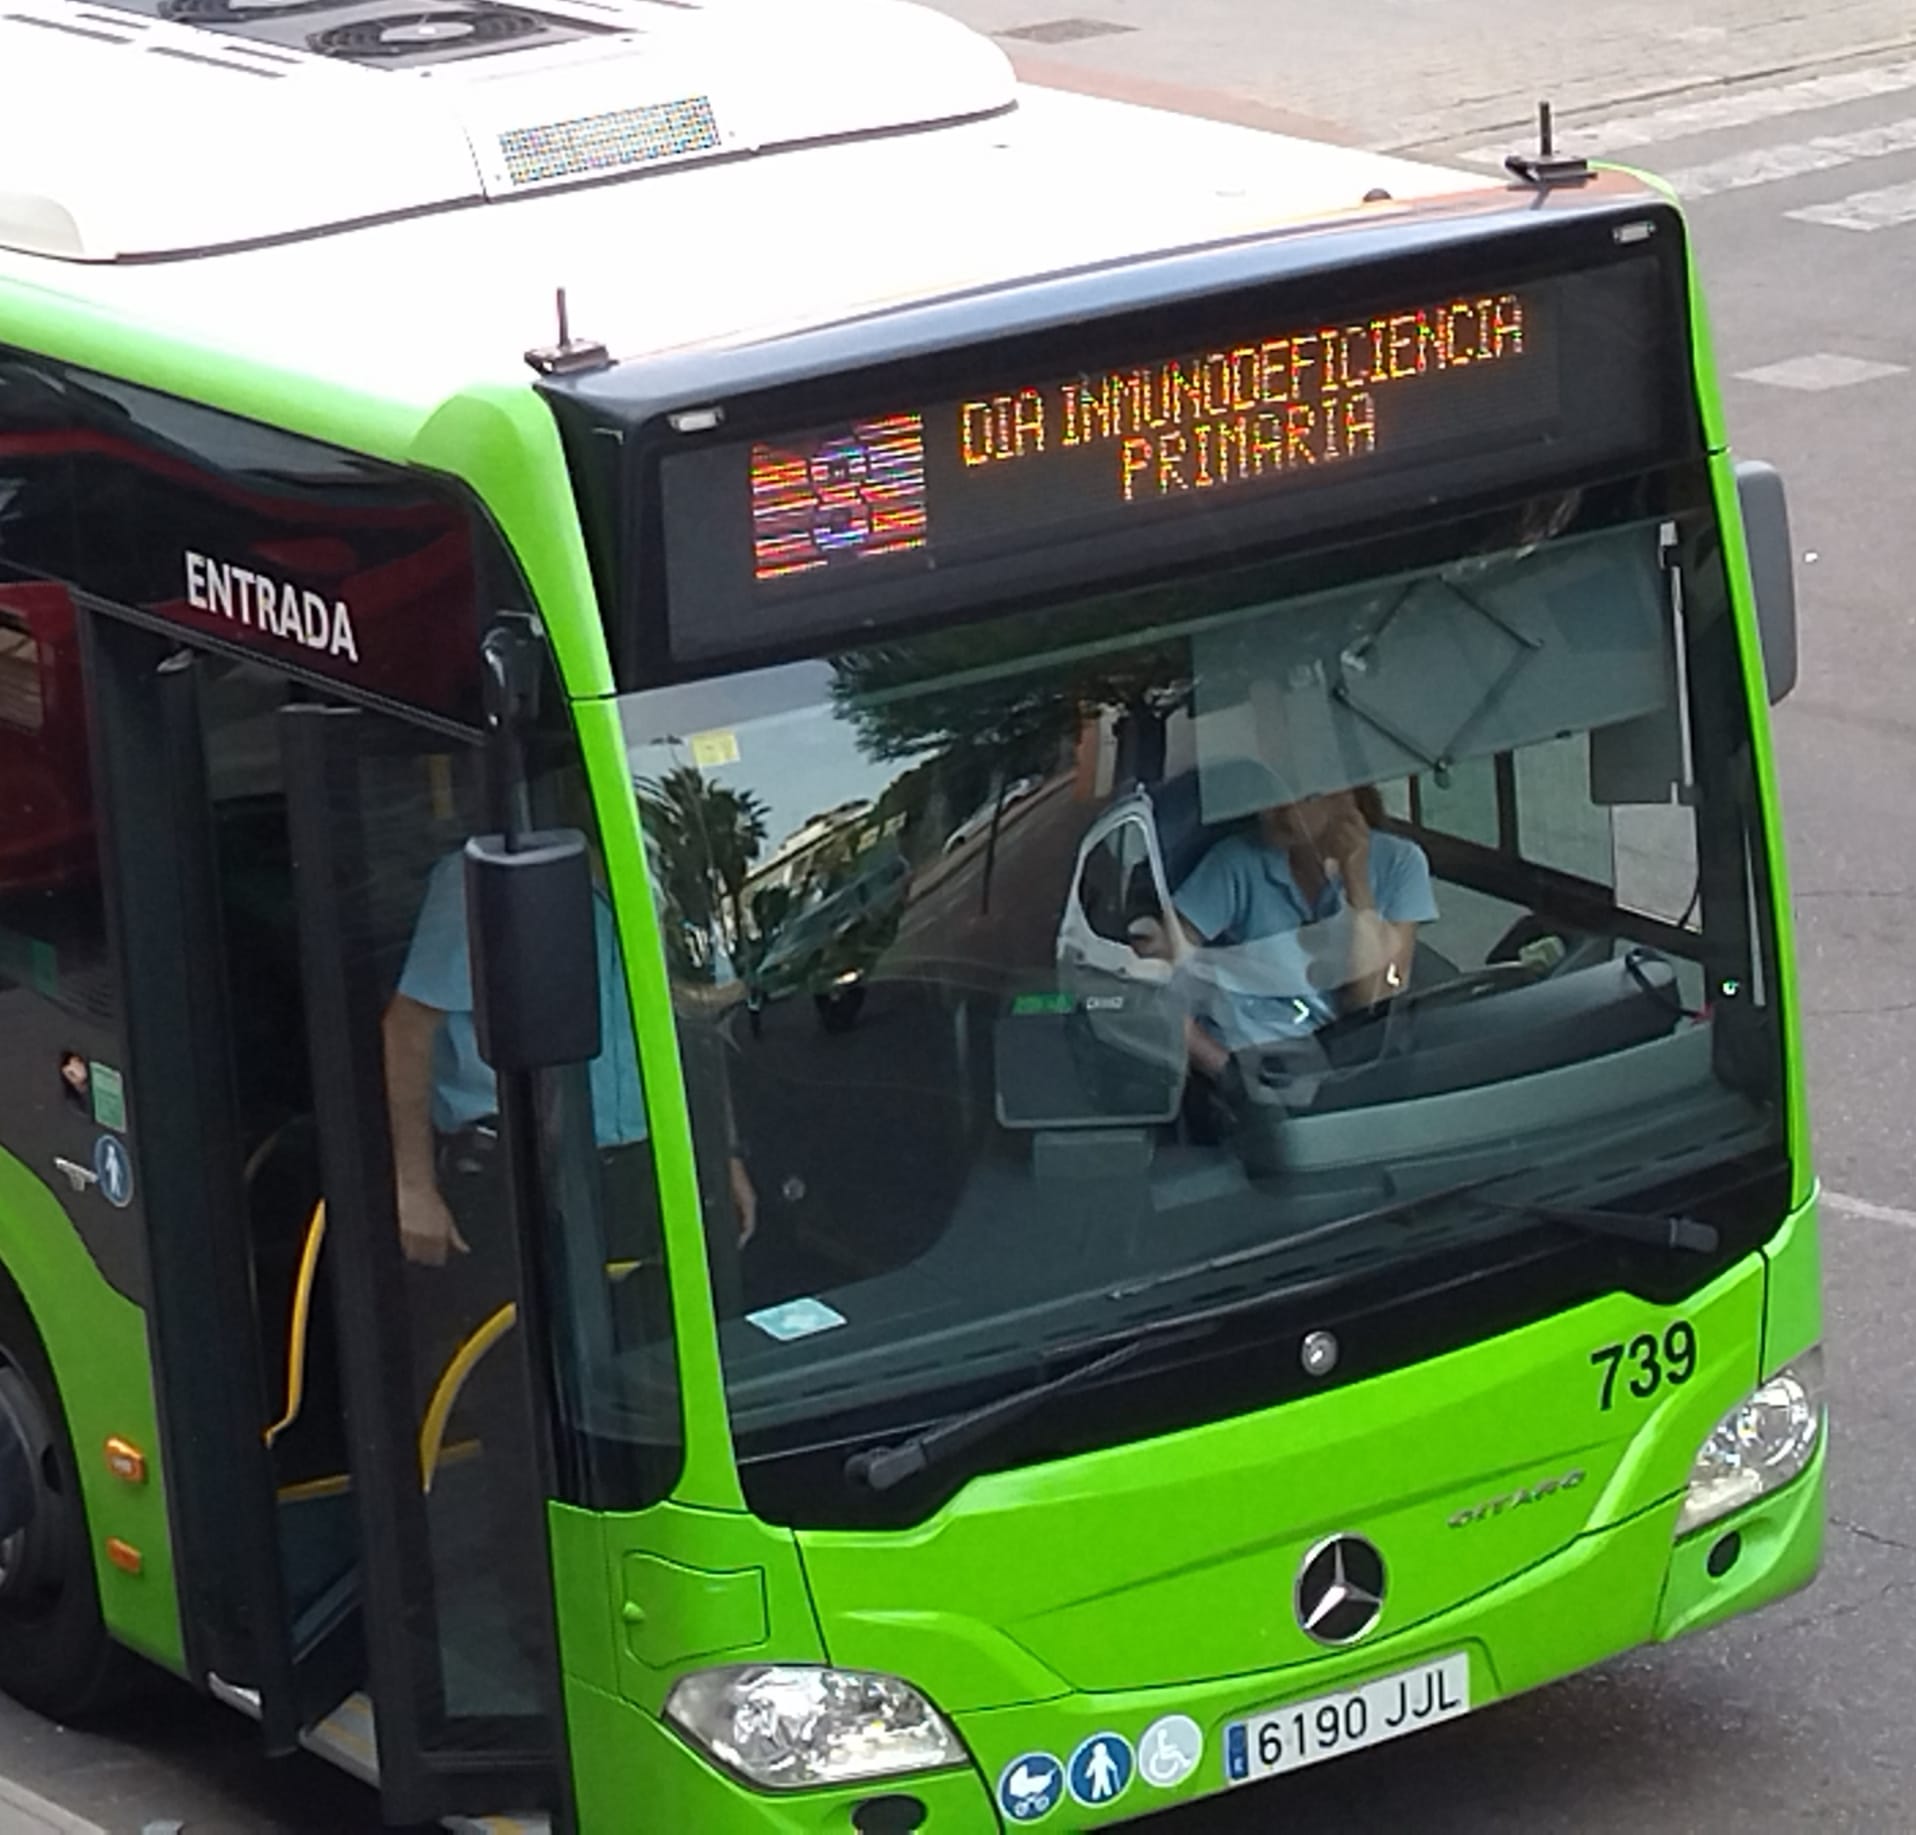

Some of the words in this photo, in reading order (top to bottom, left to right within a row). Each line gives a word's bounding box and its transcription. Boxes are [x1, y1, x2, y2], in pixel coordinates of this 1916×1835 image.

[960, 386, 1045, 468] DIA
[1061, 294, 1523, 447] INMUNODEFICIENCIA
[1120, 393, 1376, 500] PRIMARIA
[185, 550, 359, 663] ENTRADA
[1590, 1320, 1697, 1411] 739
[1258, 1696, 1367, 1765] 6190
[1385, 1669, 1461, 1727] JJL
